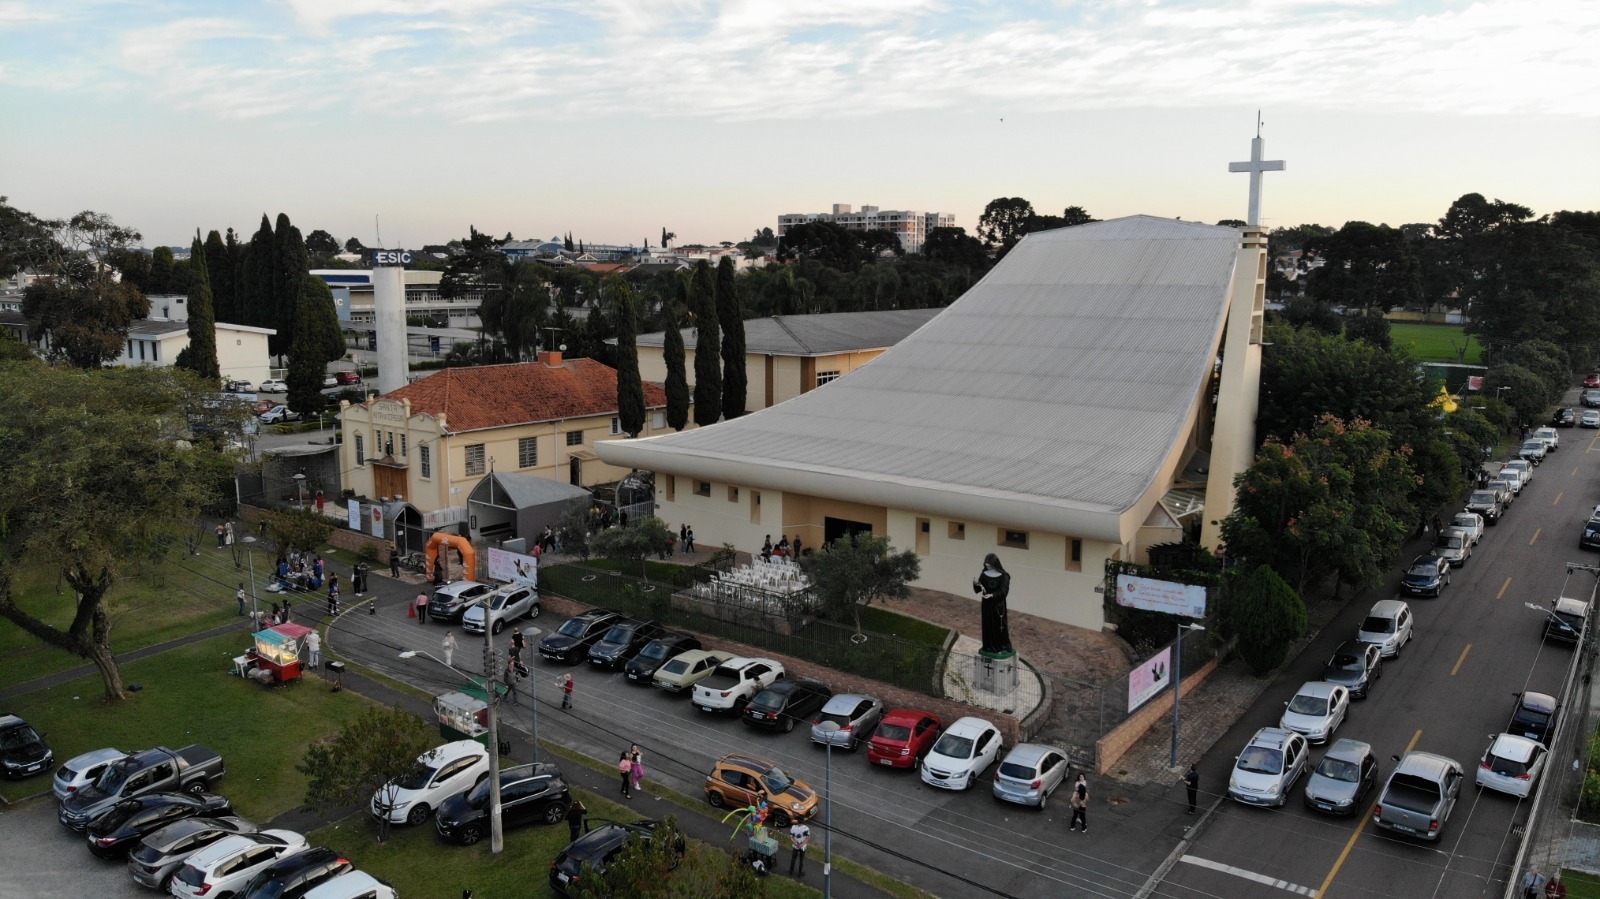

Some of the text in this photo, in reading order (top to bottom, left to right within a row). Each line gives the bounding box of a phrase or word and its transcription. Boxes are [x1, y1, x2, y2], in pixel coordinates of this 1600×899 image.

[376, 252, 411, 264] ESIC
[334, 298, 343, 306] IC
[378, 402, 398, 413] SANTA
